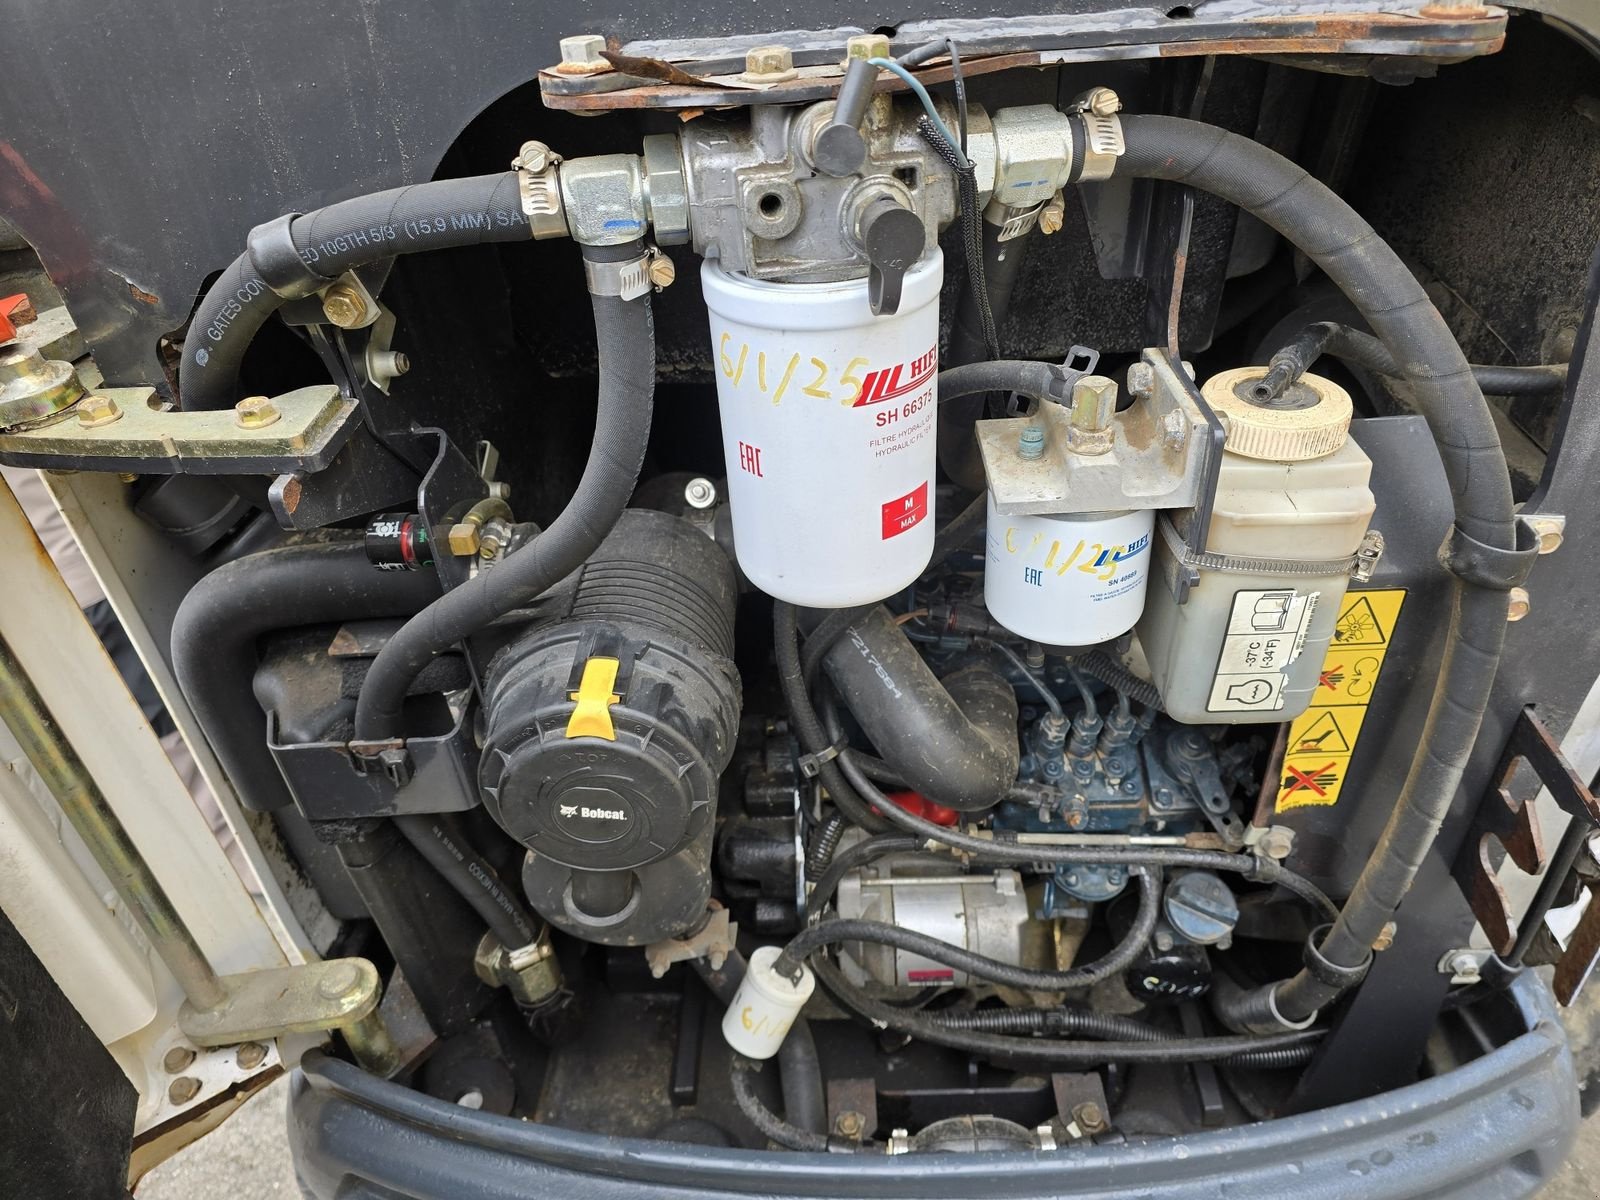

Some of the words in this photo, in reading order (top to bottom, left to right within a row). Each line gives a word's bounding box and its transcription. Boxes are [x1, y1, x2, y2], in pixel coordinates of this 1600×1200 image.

[319, 230, 370, 257] 10GTH
[404, 217, 447, 240] (15.9
[450, 211, 491, 231] MM)
[207, 299, 242, 341] GATES
[720, 331, 870, 407] 6/1/25
[876, 407, 899, 428] SH
[902, 387, 933, 418] 66375
[869, 433, 897, 448] FILTRE
[874, 436, 916, 459] HYDRAULIC
[738, 440, 764, 478] EAC
[904, 496, 914, 511] M
[900, 513, 917, 529] MAX
[1127, 532, 1149, 553] HIFI
[1024, 566, 1044, 587] EAC
[1245, 641, 1261, 667] -37°C
[1260, 639, 1281, 669] (-34°F)
